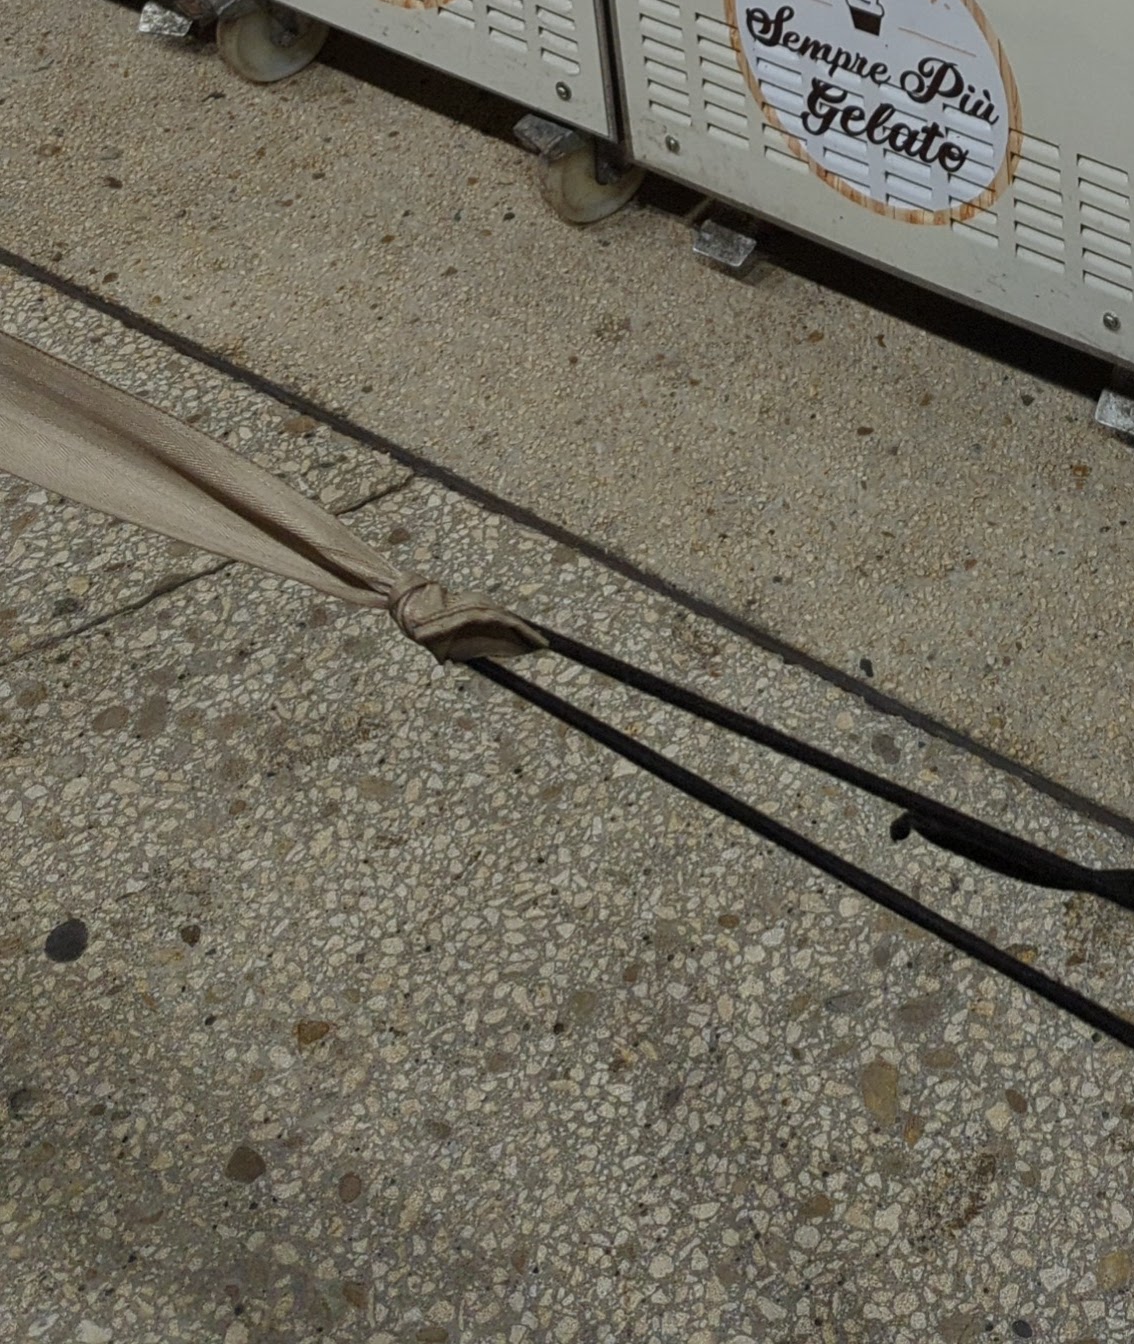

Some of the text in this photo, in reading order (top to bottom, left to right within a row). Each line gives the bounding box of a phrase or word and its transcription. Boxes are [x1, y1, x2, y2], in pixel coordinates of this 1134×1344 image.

[746, 6, 999, 126] Sempre Più
[801, 77, 970, 173] Gelato
